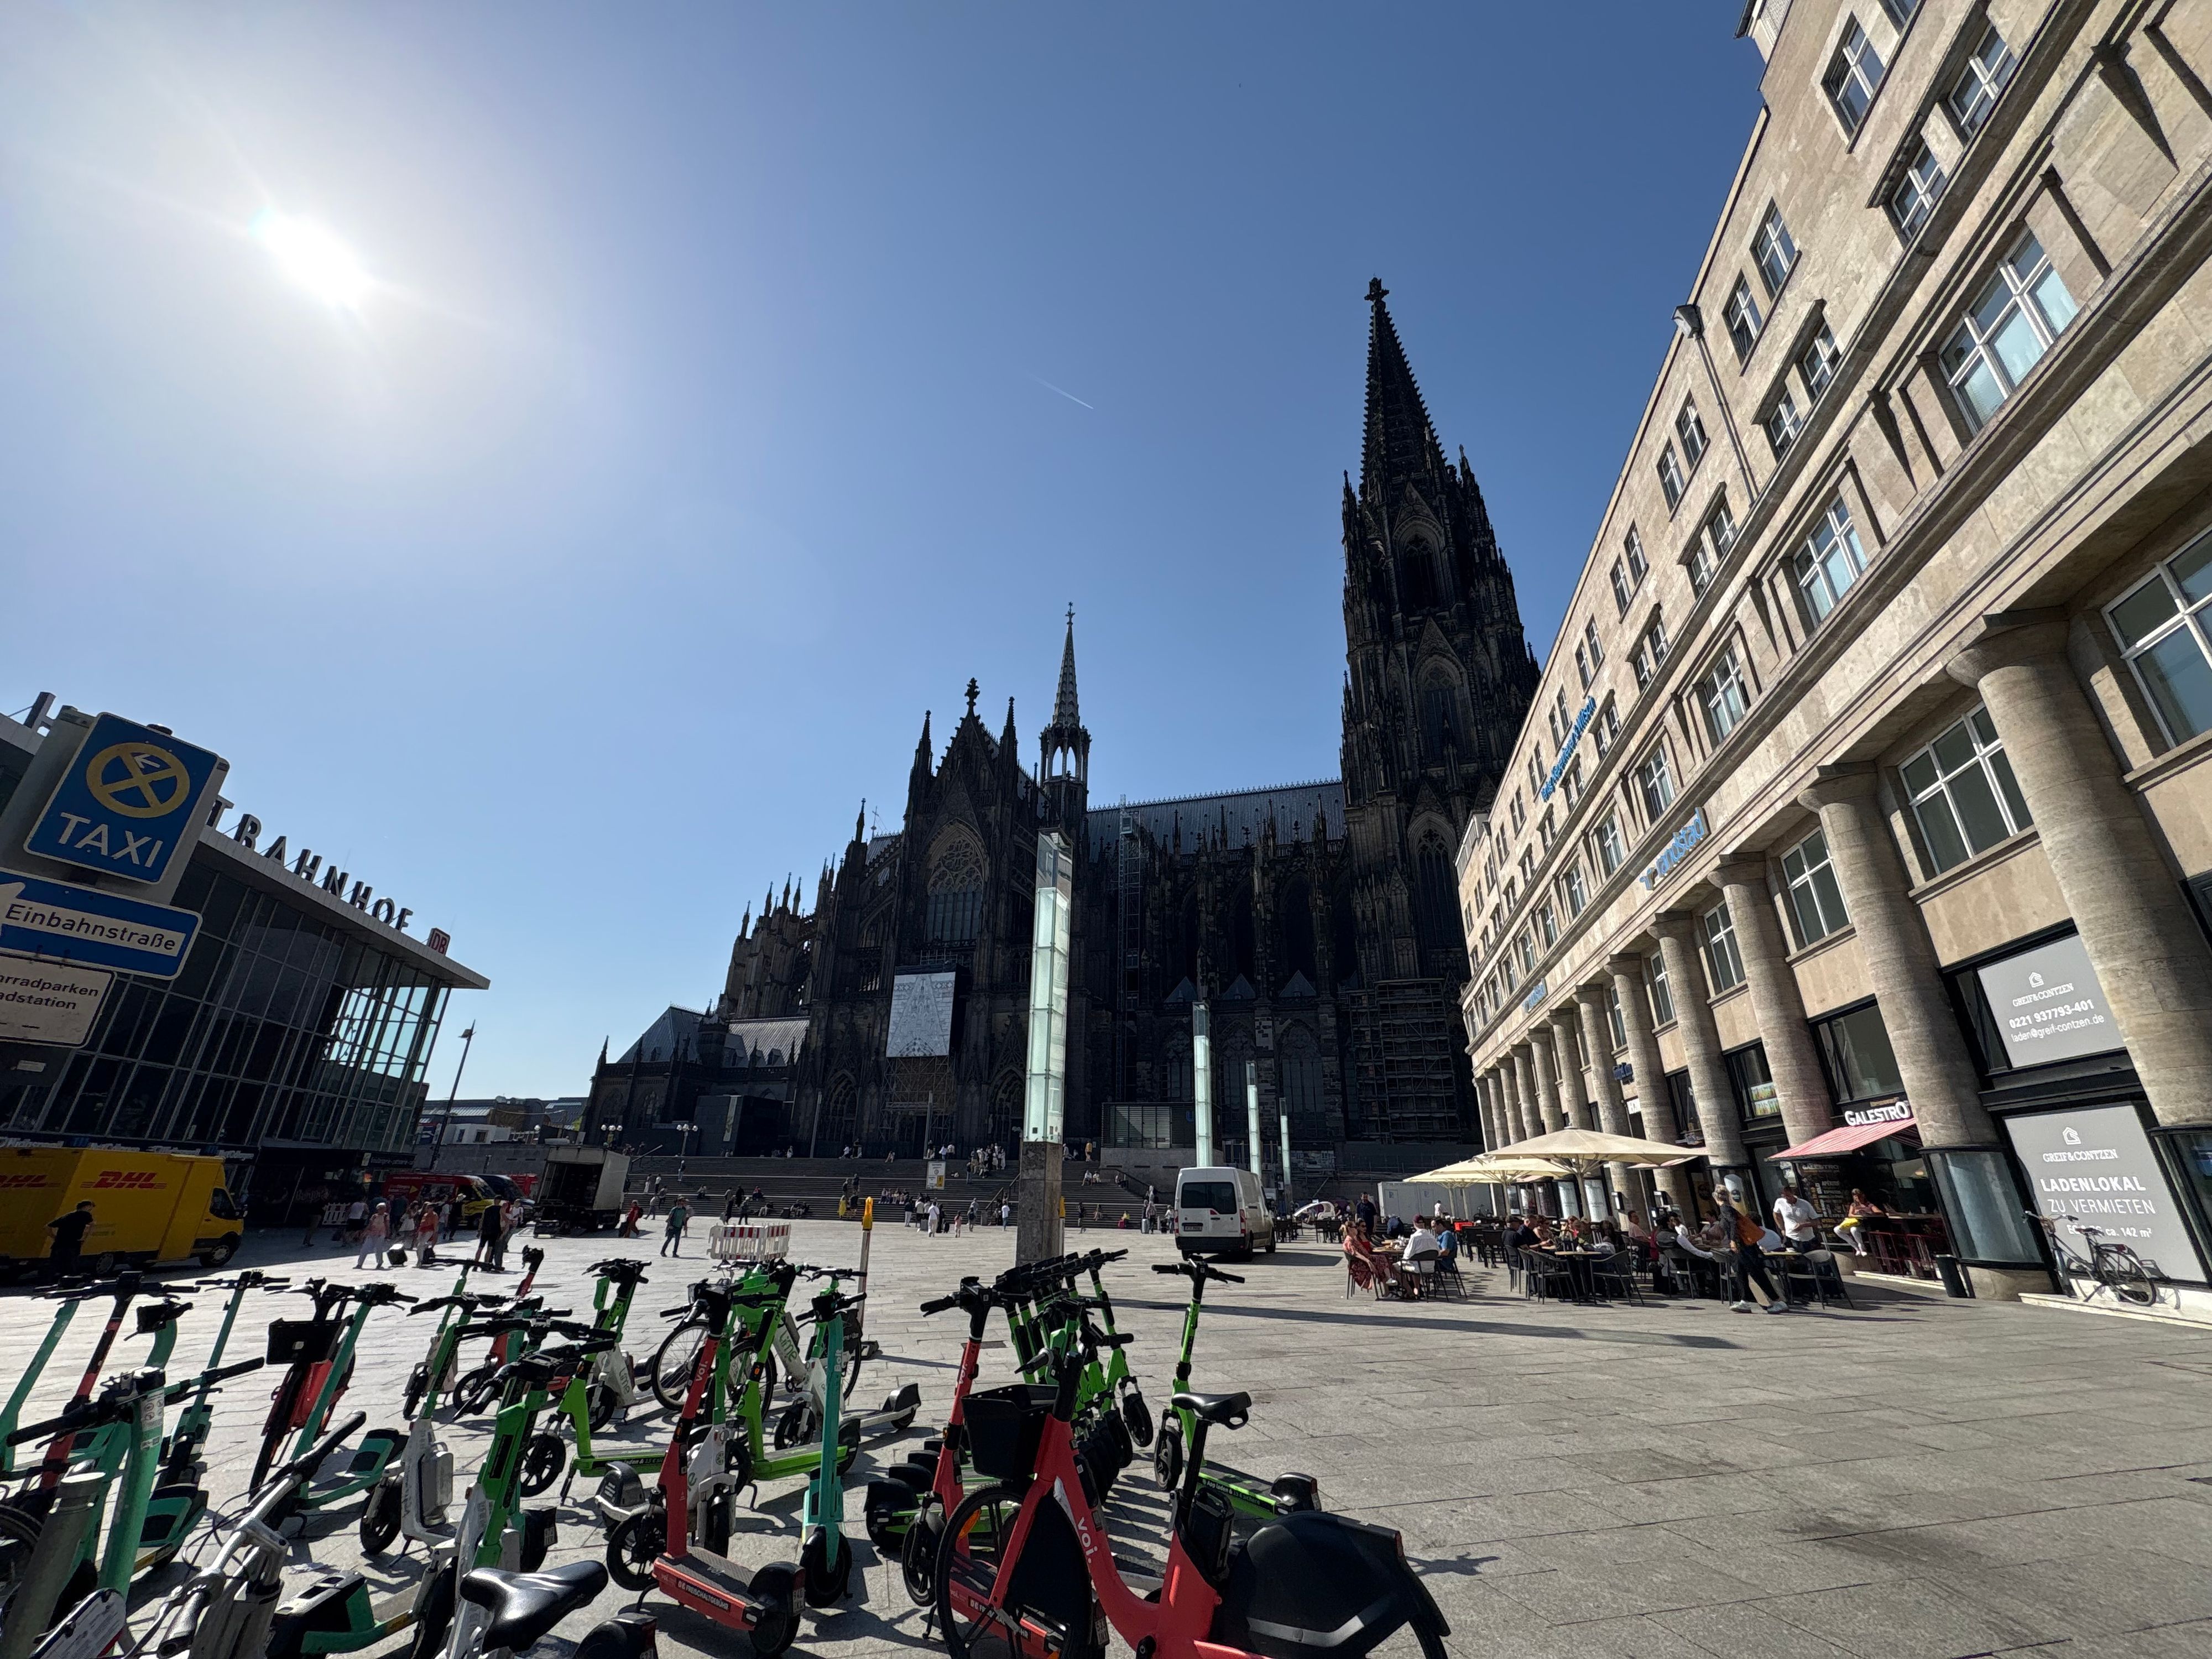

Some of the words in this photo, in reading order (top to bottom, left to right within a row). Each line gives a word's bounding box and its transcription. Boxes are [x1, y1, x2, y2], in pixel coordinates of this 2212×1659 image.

[58, 811, 164, 868] TAXI
[5, 902, 176, 951] Einbahnstraße
[431, 931, 447, 954] DB
[2012, 983, 2074, 1007] GREIF&CONTZEN
[2008, 1015, 2032, 1029] 0221
[2033, 999, 2095, 1023] 937793-401
[2011, 1014, 2105, 1043] laden@greif-contzen.de
[1844, 1101, 1910, 1126] GALESTRO
[2042, 1149, 2119, 1163] GREIF&CONTZEN
[93, 1170, 158, 1189] DHL
[2040, 1176, 2146, 1192] LADENLOKAL
[2047, 1199, 2066, 1213] ZU
[2069, 1198, 2156, 1215] VERMIETEN
[2105, 1228, 2119, 1237] ca.
[2120, 1227, 2138, 1238] 142
[696, 1360, 708, 1381] voi.
[834, 1349, 842, 1372] Bolt
[1077, 1516, 1098, 1564] voi.
